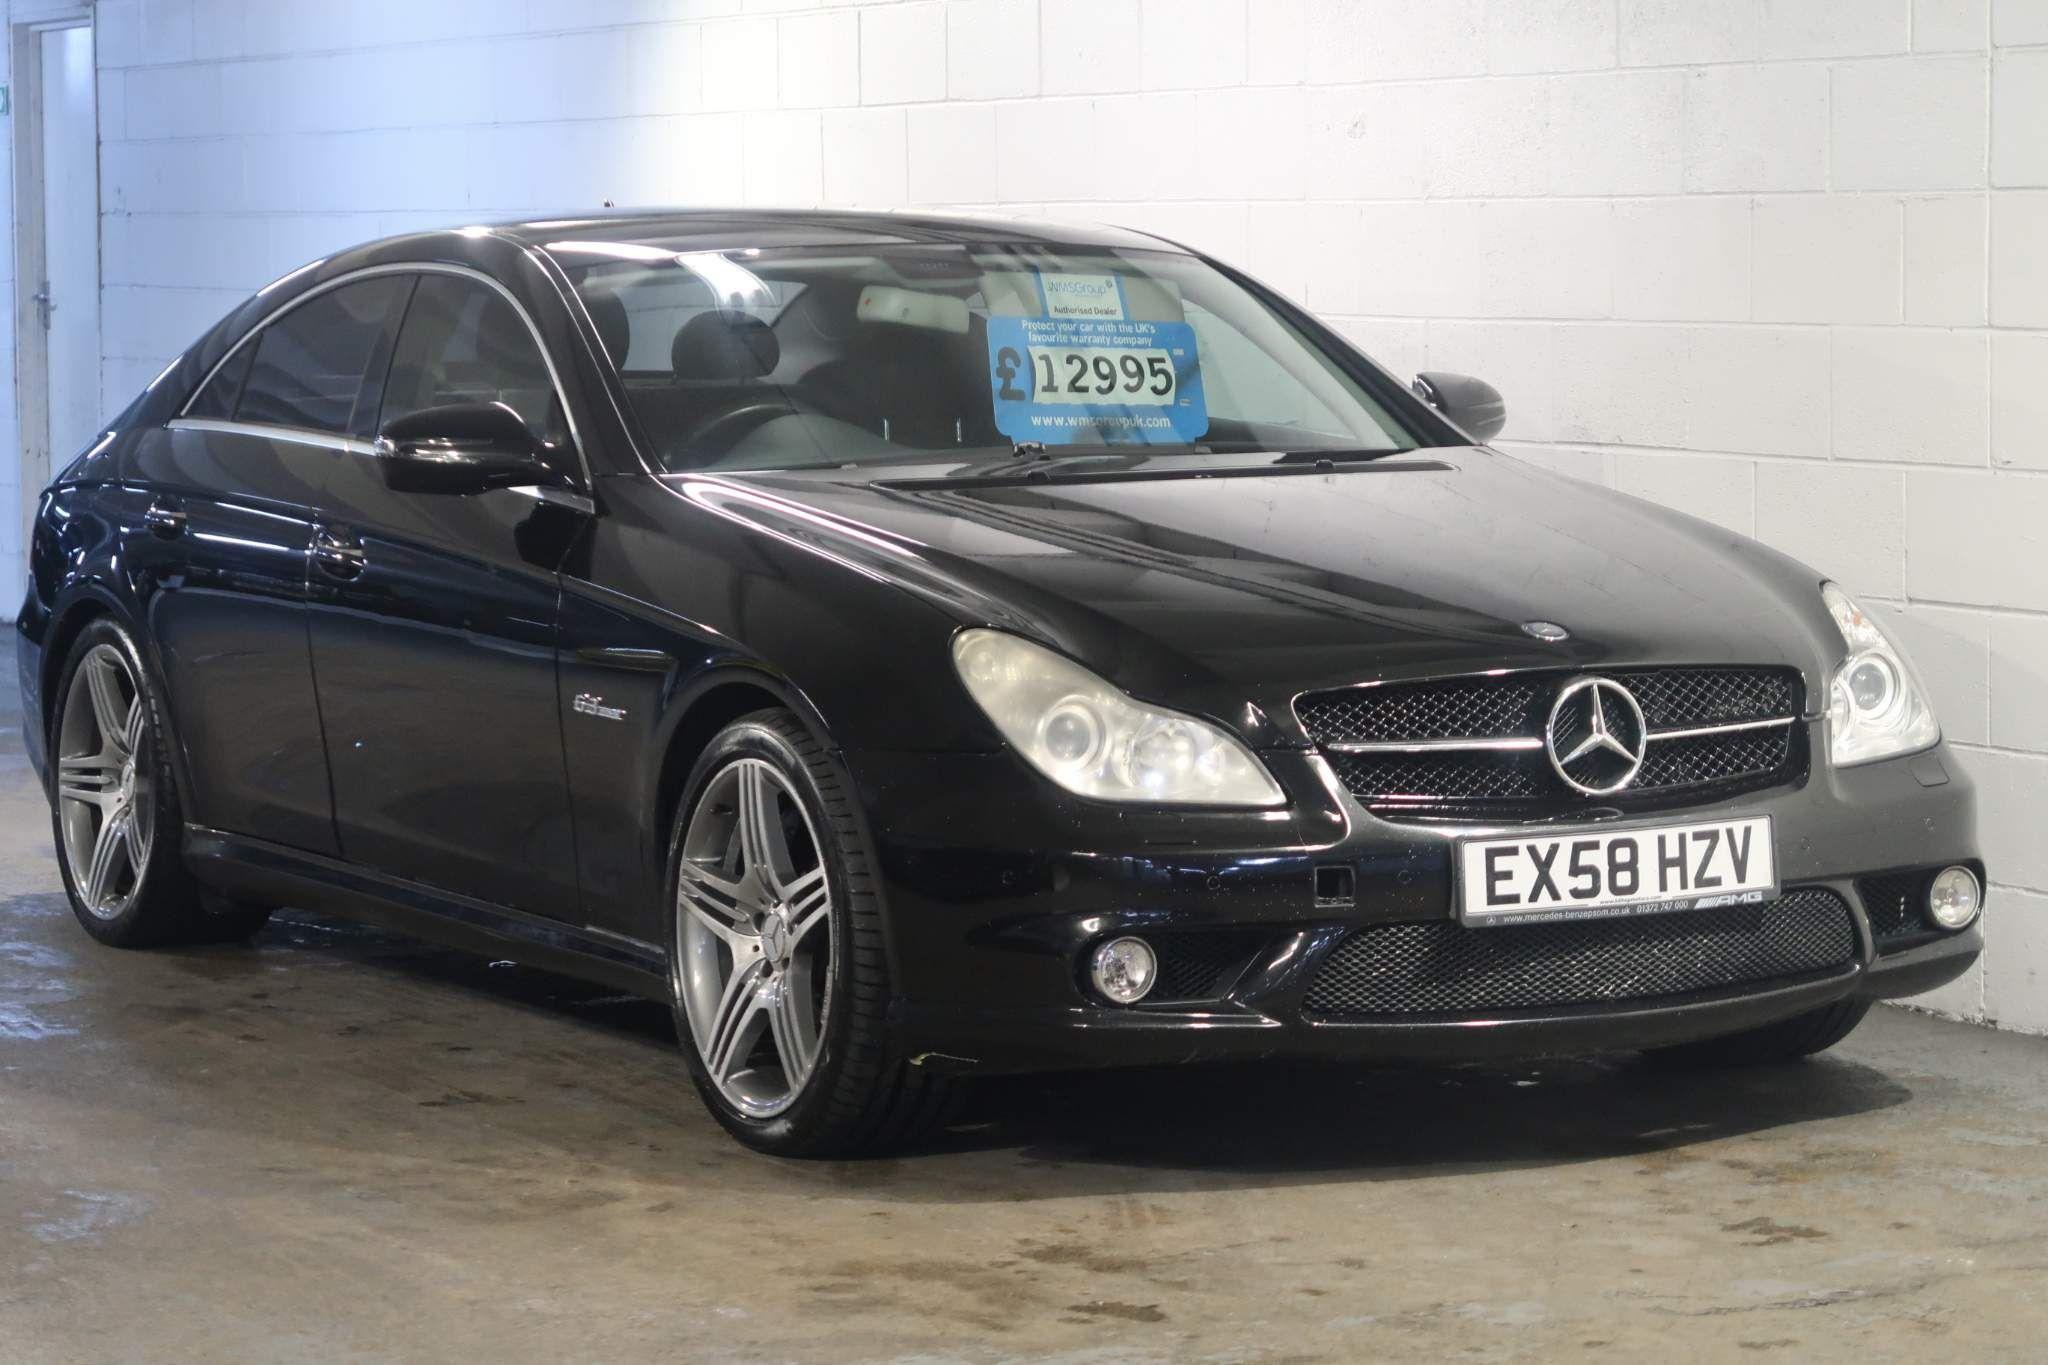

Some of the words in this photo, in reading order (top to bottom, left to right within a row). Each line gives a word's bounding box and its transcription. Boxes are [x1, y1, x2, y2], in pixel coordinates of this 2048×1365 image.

[1054, 305, 1092, 315] Authorised
[1094, 307, 1118, 316] Dealer
[1022, 319, 1055, 331] Protect
[1057, 321, 1077, 333] your
[1079, 323, 1094, 333] car
[1096, 322, 1118, 333] with
[1119, 322, 1134, 334] the
[1135, 323, 1156, 334] UK's
[1028, 331, 1068, 343] favourite
[1070, 334, 1111, 347] warranty
[1113, 335, 1152, 347] company
[1038, 354, 1174, 396] 12995
[1031, 414, 1171, 429] www.wmsgroupuk.com
[1484, 837, 1640, 907] EX58
[1657, 824, 1752, 893] HZV
[1636, 902, 1659, 913] 01372
[1660, 901, 1673, 912] 747
